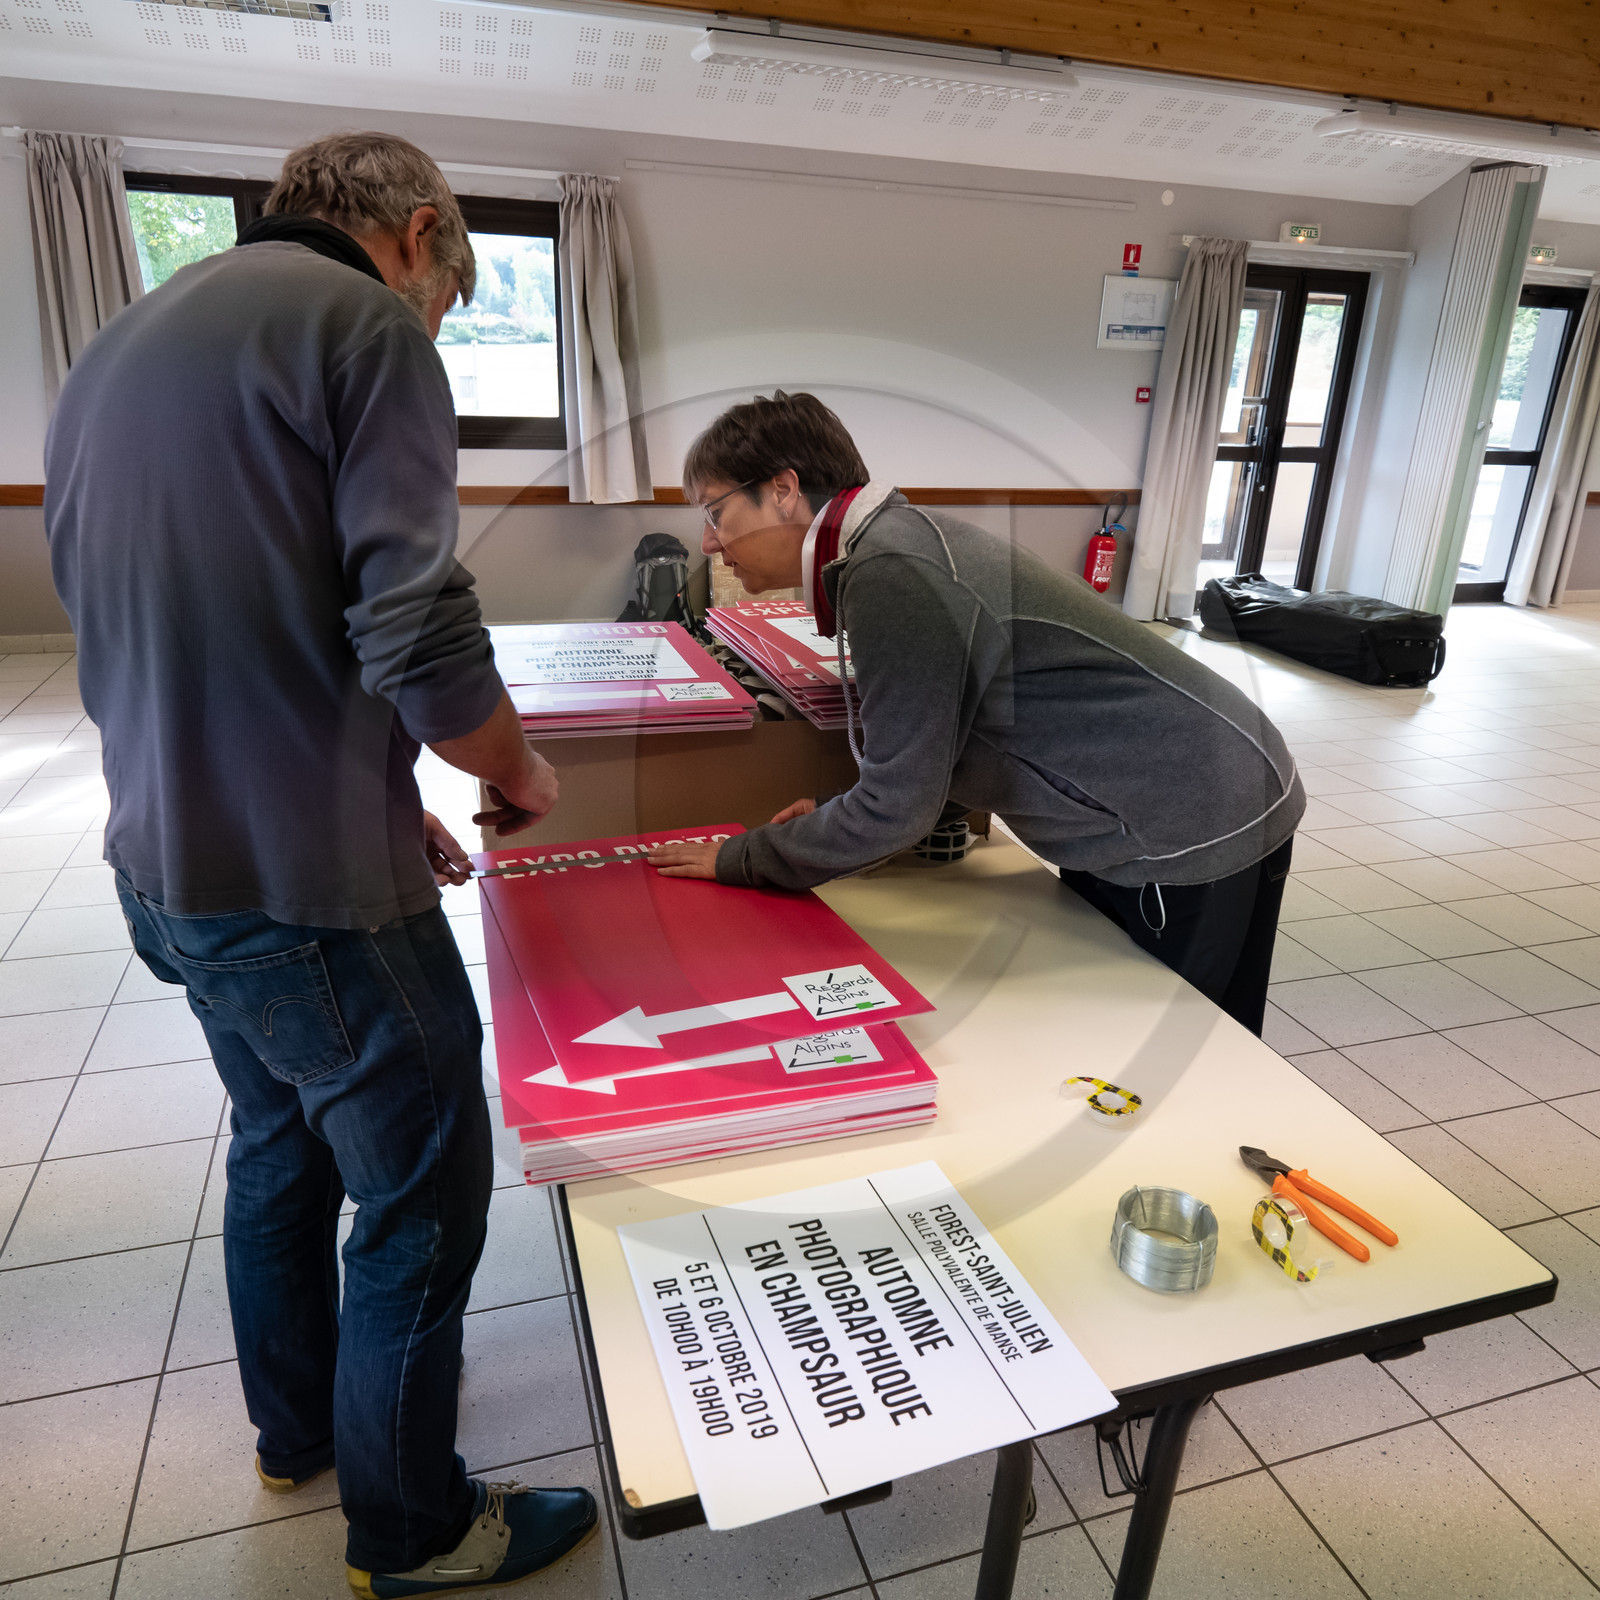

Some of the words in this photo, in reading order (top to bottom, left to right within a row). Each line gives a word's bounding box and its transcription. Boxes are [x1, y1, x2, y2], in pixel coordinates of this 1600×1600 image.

[1291, 227, 1318, 238] SORTIE
[1532, 247, 1555, 257] SORTIE
[570, 625, 669, 637] PHOTO
[525, 653, 659, 664] PHOTOGRAPHIQUE
[536, 662, 557, 670] EN
[561, 660, 657, 669] CHAMPSAUR
[554, 648, 626, 657] AUTOMNE
[580, 669, 628, 677] OCTOBRE
[496, 850, 604, 880] EXPO
[907, 1211, 938, 1240] SALLE
[684, 1261, 710, 1273] 5
[744, 1239, 789, 1272] EN
[689, 1275, 719, 1293] ET
[926, 1238, 984, 1306] POLYVALENTE
[929, 1203, 1054, 1355] FOREST-SAINT-JULIEN
[652, 1277, 682, 1300] DE
[858, 1246, 955, 1357] AUTOMNE
[698, 1296, 724, 1309] 6
[972, 1305, 995, 1322] DE
[662, 1301, 704, 1355] 10H00
[788, 1218, 933, 1427] PHOTOGRAPHIQUE
[704, 1310, 757, 1387] OCTOBRE
[760, 1272, 866, 1429] CHAMPSAUR
[983, 1321, 1024, 1363] MANSE
[681, 1357, 714, 1372] À
[689, 1374, 735, 1437] 19H00
[735, 1387, 779, 1439] 2019
